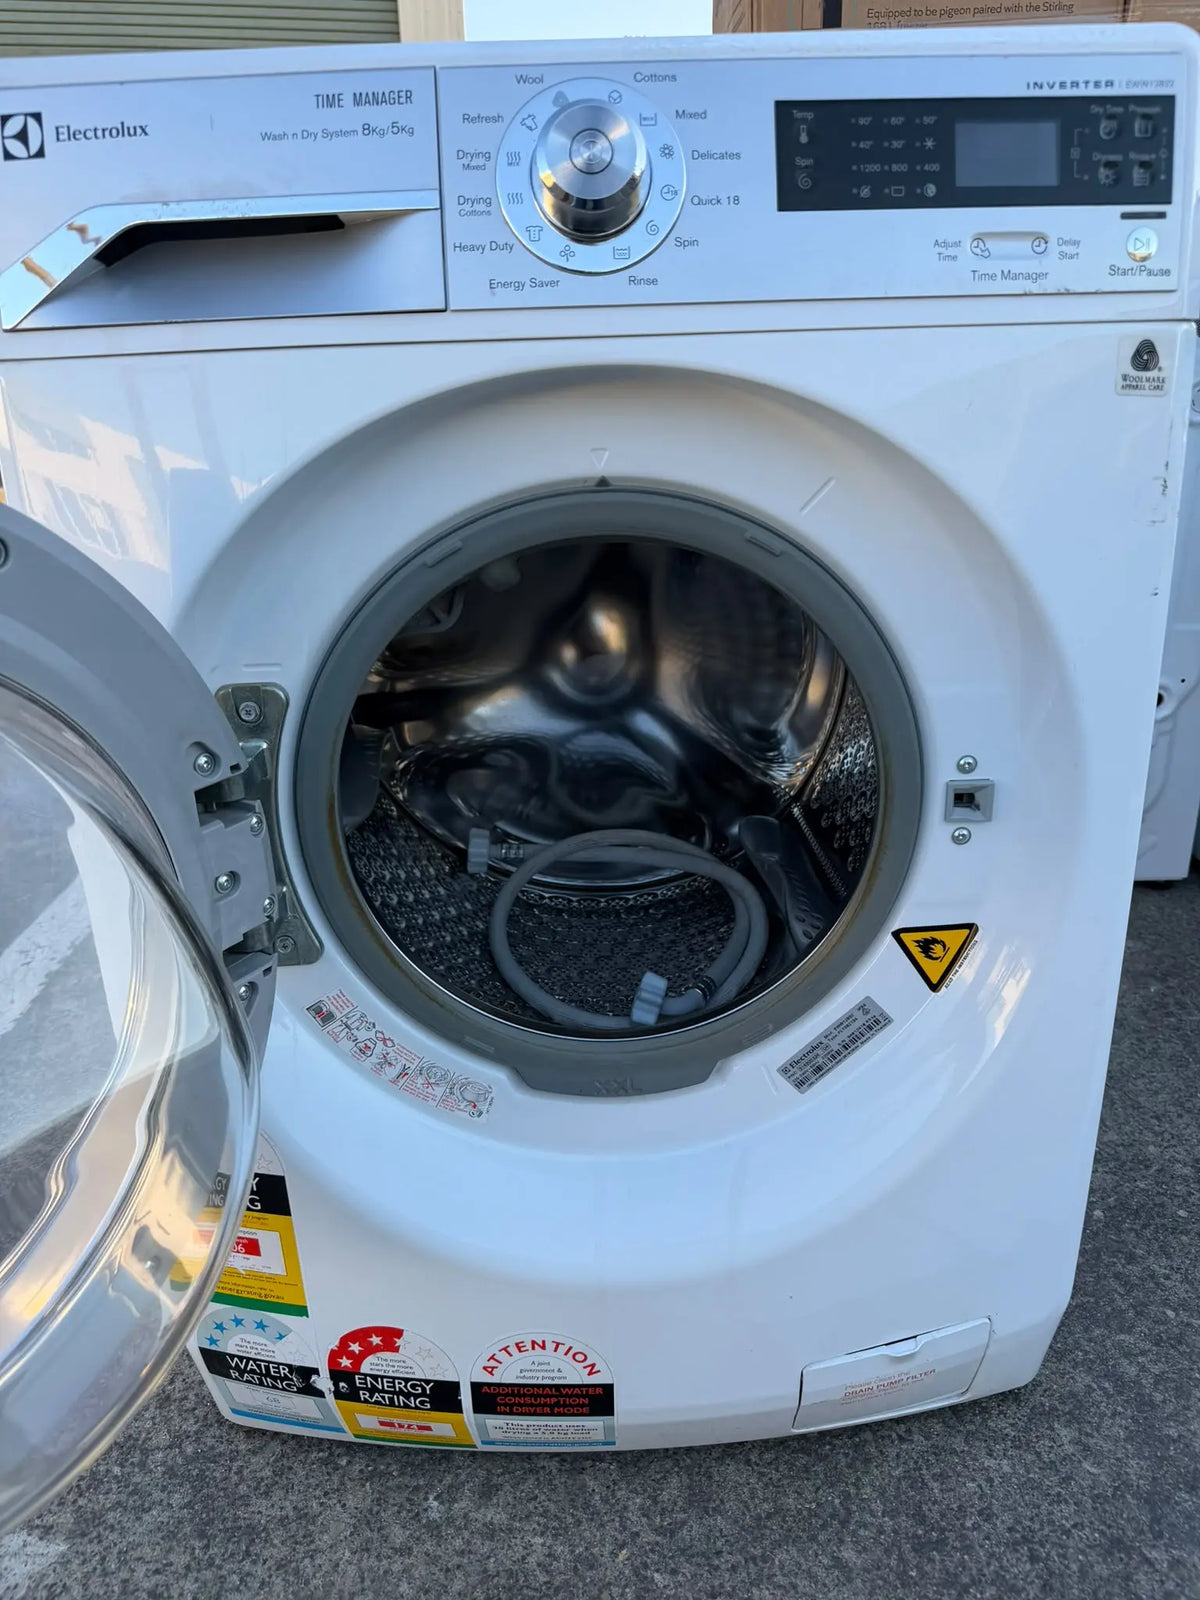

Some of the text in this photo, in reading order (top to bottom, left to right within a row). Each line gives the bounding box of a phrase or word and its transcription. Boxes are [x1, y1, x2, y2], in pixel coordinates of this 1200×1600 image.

[867, 2, 1074, 20] Equipped to be pigeon paired with the Stirling
[515, 74, 544, 85] Wool
[633, 72, 677, 83] Cottons
[1026, 80, 1115, 90] INVERTER
[314, 90, 414, 109] TIME MANAGER
[462, 113, 505, 124] Refresh
[675, 109, 707, 120] Mixed
[792, 110, 814, 120] Temp
[54, 121, 150, 143] Electrolux
[260, 121, 415, 142] Wash n Dry System 8Kg/5Kg
[456, 149, 491, 162] Drying
[691, 150, 742, 161] Delicates
[795, 156, 814, 166] Spin
[462, 163, 486, 171] Mixed
[859, 163, 940, 172] 1200 800 400
[457, 195, 492, 208] Drying
[690, 195, 741, 206] Quick 18
[458, 209, 492, 217] Cottons
[453, 241, 514, 254] Heavy Duty
[674, 236, 699, 250] Spin
[933, 239, 962, 250] Adjust
[1057, 237, 1081, 249] Delay
[937, 253, 958, 262] Time
[1058, 251, 1079, 261] Start
[970, 268, 1049, 283] Time Manager
[1108, 264, 1171, 278] Start/Pause
[488, 277, 560, 292] Energy Saver
[628, 275, 658, 286] Rinse
[1120, 374, 1166, 384] WOOLMARK
[788, 1040, 825, 1069] Electrolux
[482, 1339, 601, 1377] ATTENTION
[226, 1355, 293, 1379] WATER
[230, 1369, 298, 1392] RATING
[355, 1375, 435, 1395] ENERGY
[844, 1386, 874, 1397] DRAIN
[876, 1378, 904, 1390] PUMP
[906, 1368, 936, 1381] FILTER
[481, 1385, 603, 1395] ADDITIONAL WATER
[359, 1390, 431, 1409] RATING
[496, 1396, 589, 1405] CONSUMPTION
[497, 1405, 590, 1414] IN DRYER MODE
